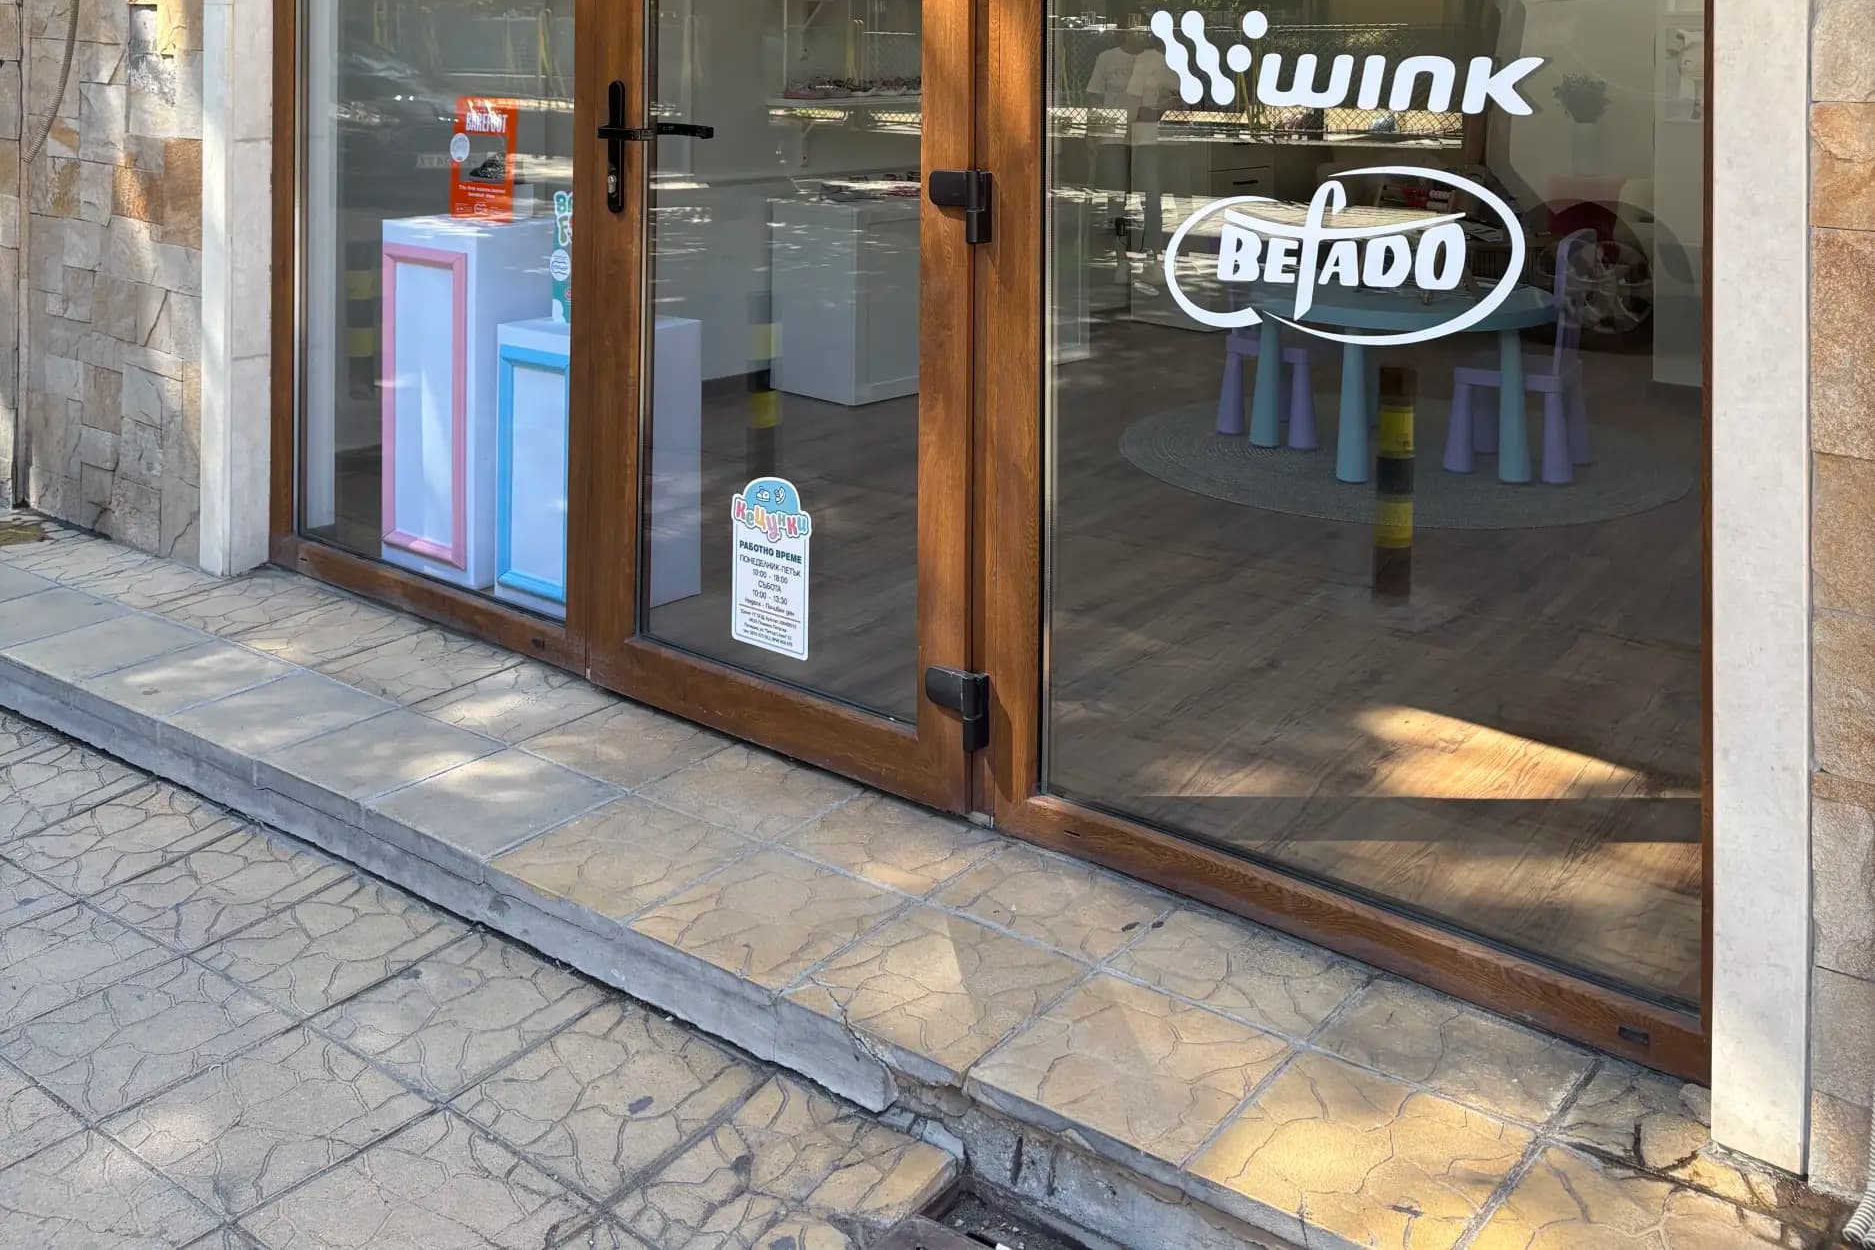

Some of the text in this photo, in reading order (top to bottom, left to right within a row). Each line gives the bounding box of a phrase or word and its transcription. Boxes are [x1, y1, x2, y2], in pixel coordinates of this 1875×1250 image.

[739, 540, 802, 564] РАБОТНО ВРЕМЕ
[757, 580, 782, 593] СЪБОТА
